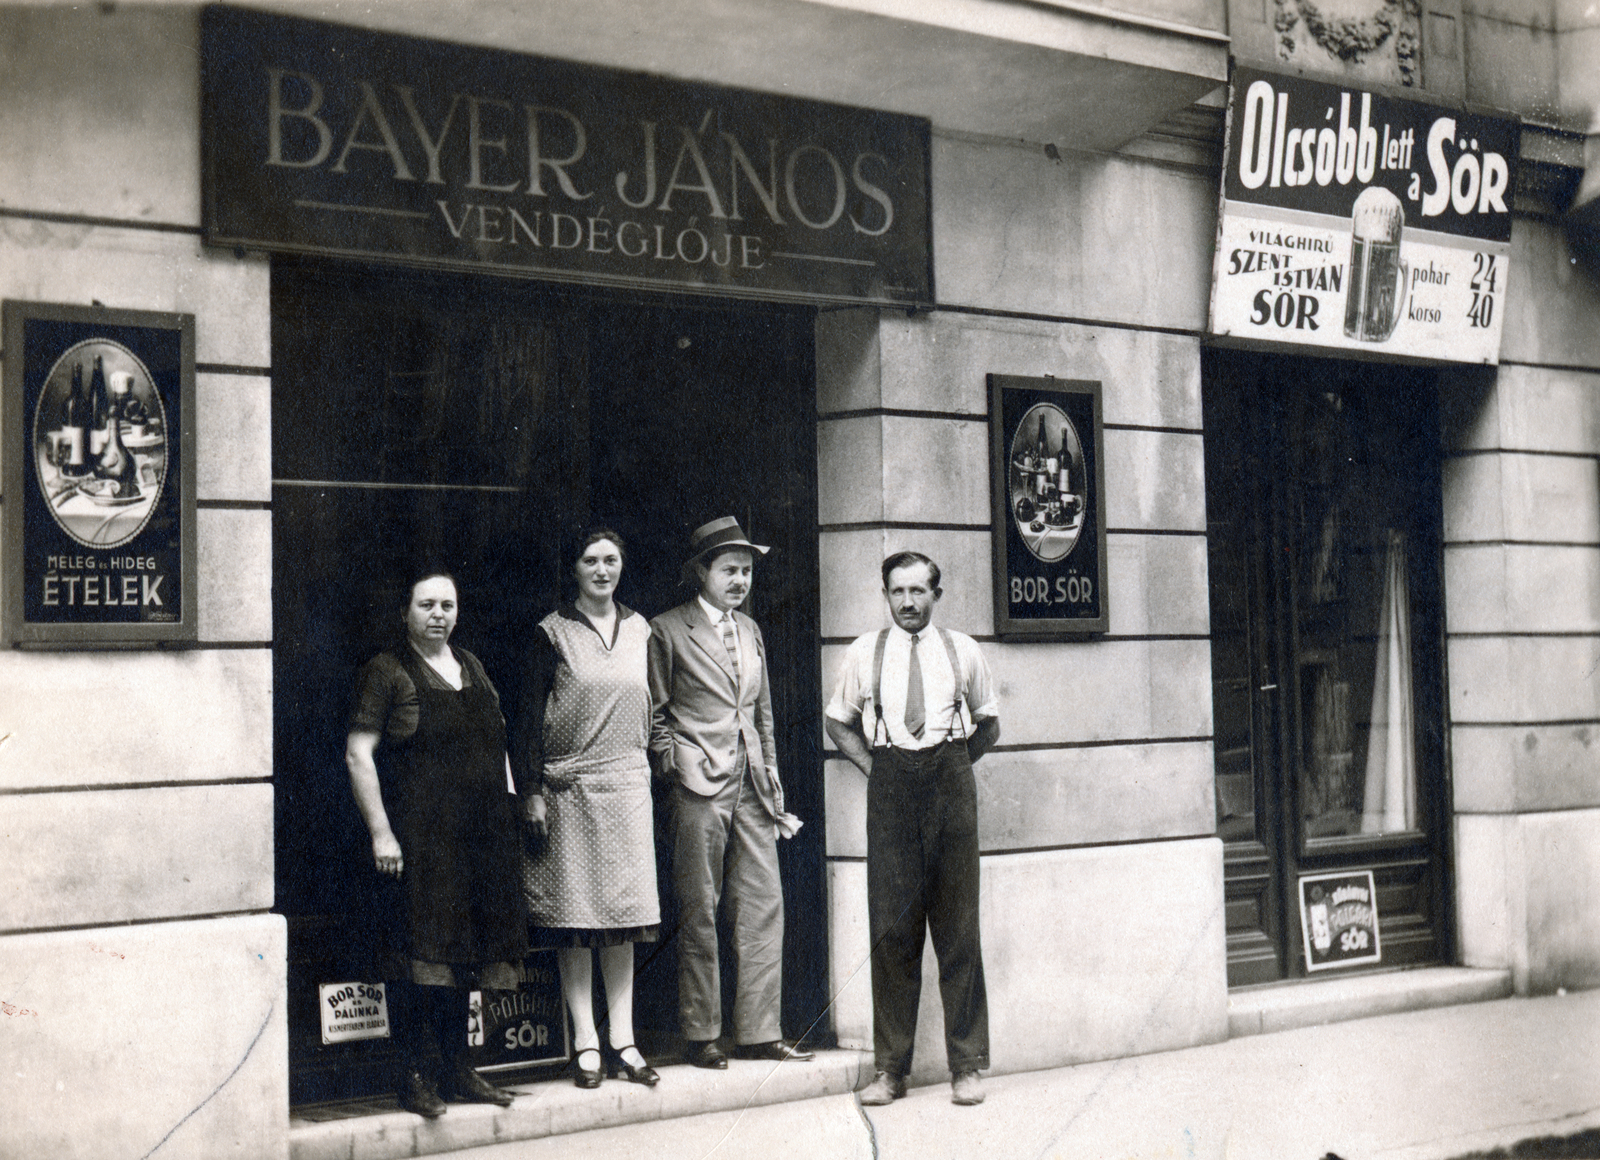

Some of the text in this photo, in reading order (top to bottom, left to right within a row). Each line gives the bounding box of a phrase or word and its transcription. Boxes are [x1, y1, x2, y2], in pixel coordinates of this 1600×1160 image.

[265, 68, 894, 236] BAYER JÁNOS
[1239, 80, 1377, 189] Olcsóbb
[1380, 124, 1414, 169] lett
[1407, 172, 1421, 200] a
[437, 200, 765, 269] VENDÉGLŐJE
[1228, 248, 1292, 275] SZENT
[1273, 259, 1343, 292] ISTVÁN
[1470, 252, 1496, 292] 24
[1250, 287, 1320, 331] SÖR
[1466, 292, 1494, 328] 40
[48, 555, 96, 570] MELEG
[110, 556, 156, 571] HIDEG
[43, 570, 165, 606] ÉTELEK
[327, 986, 355, 1008] BOR
[334, 1005, 380, 1020] PÁLINKA
[505, 1020, 548, 1050] SÖR
